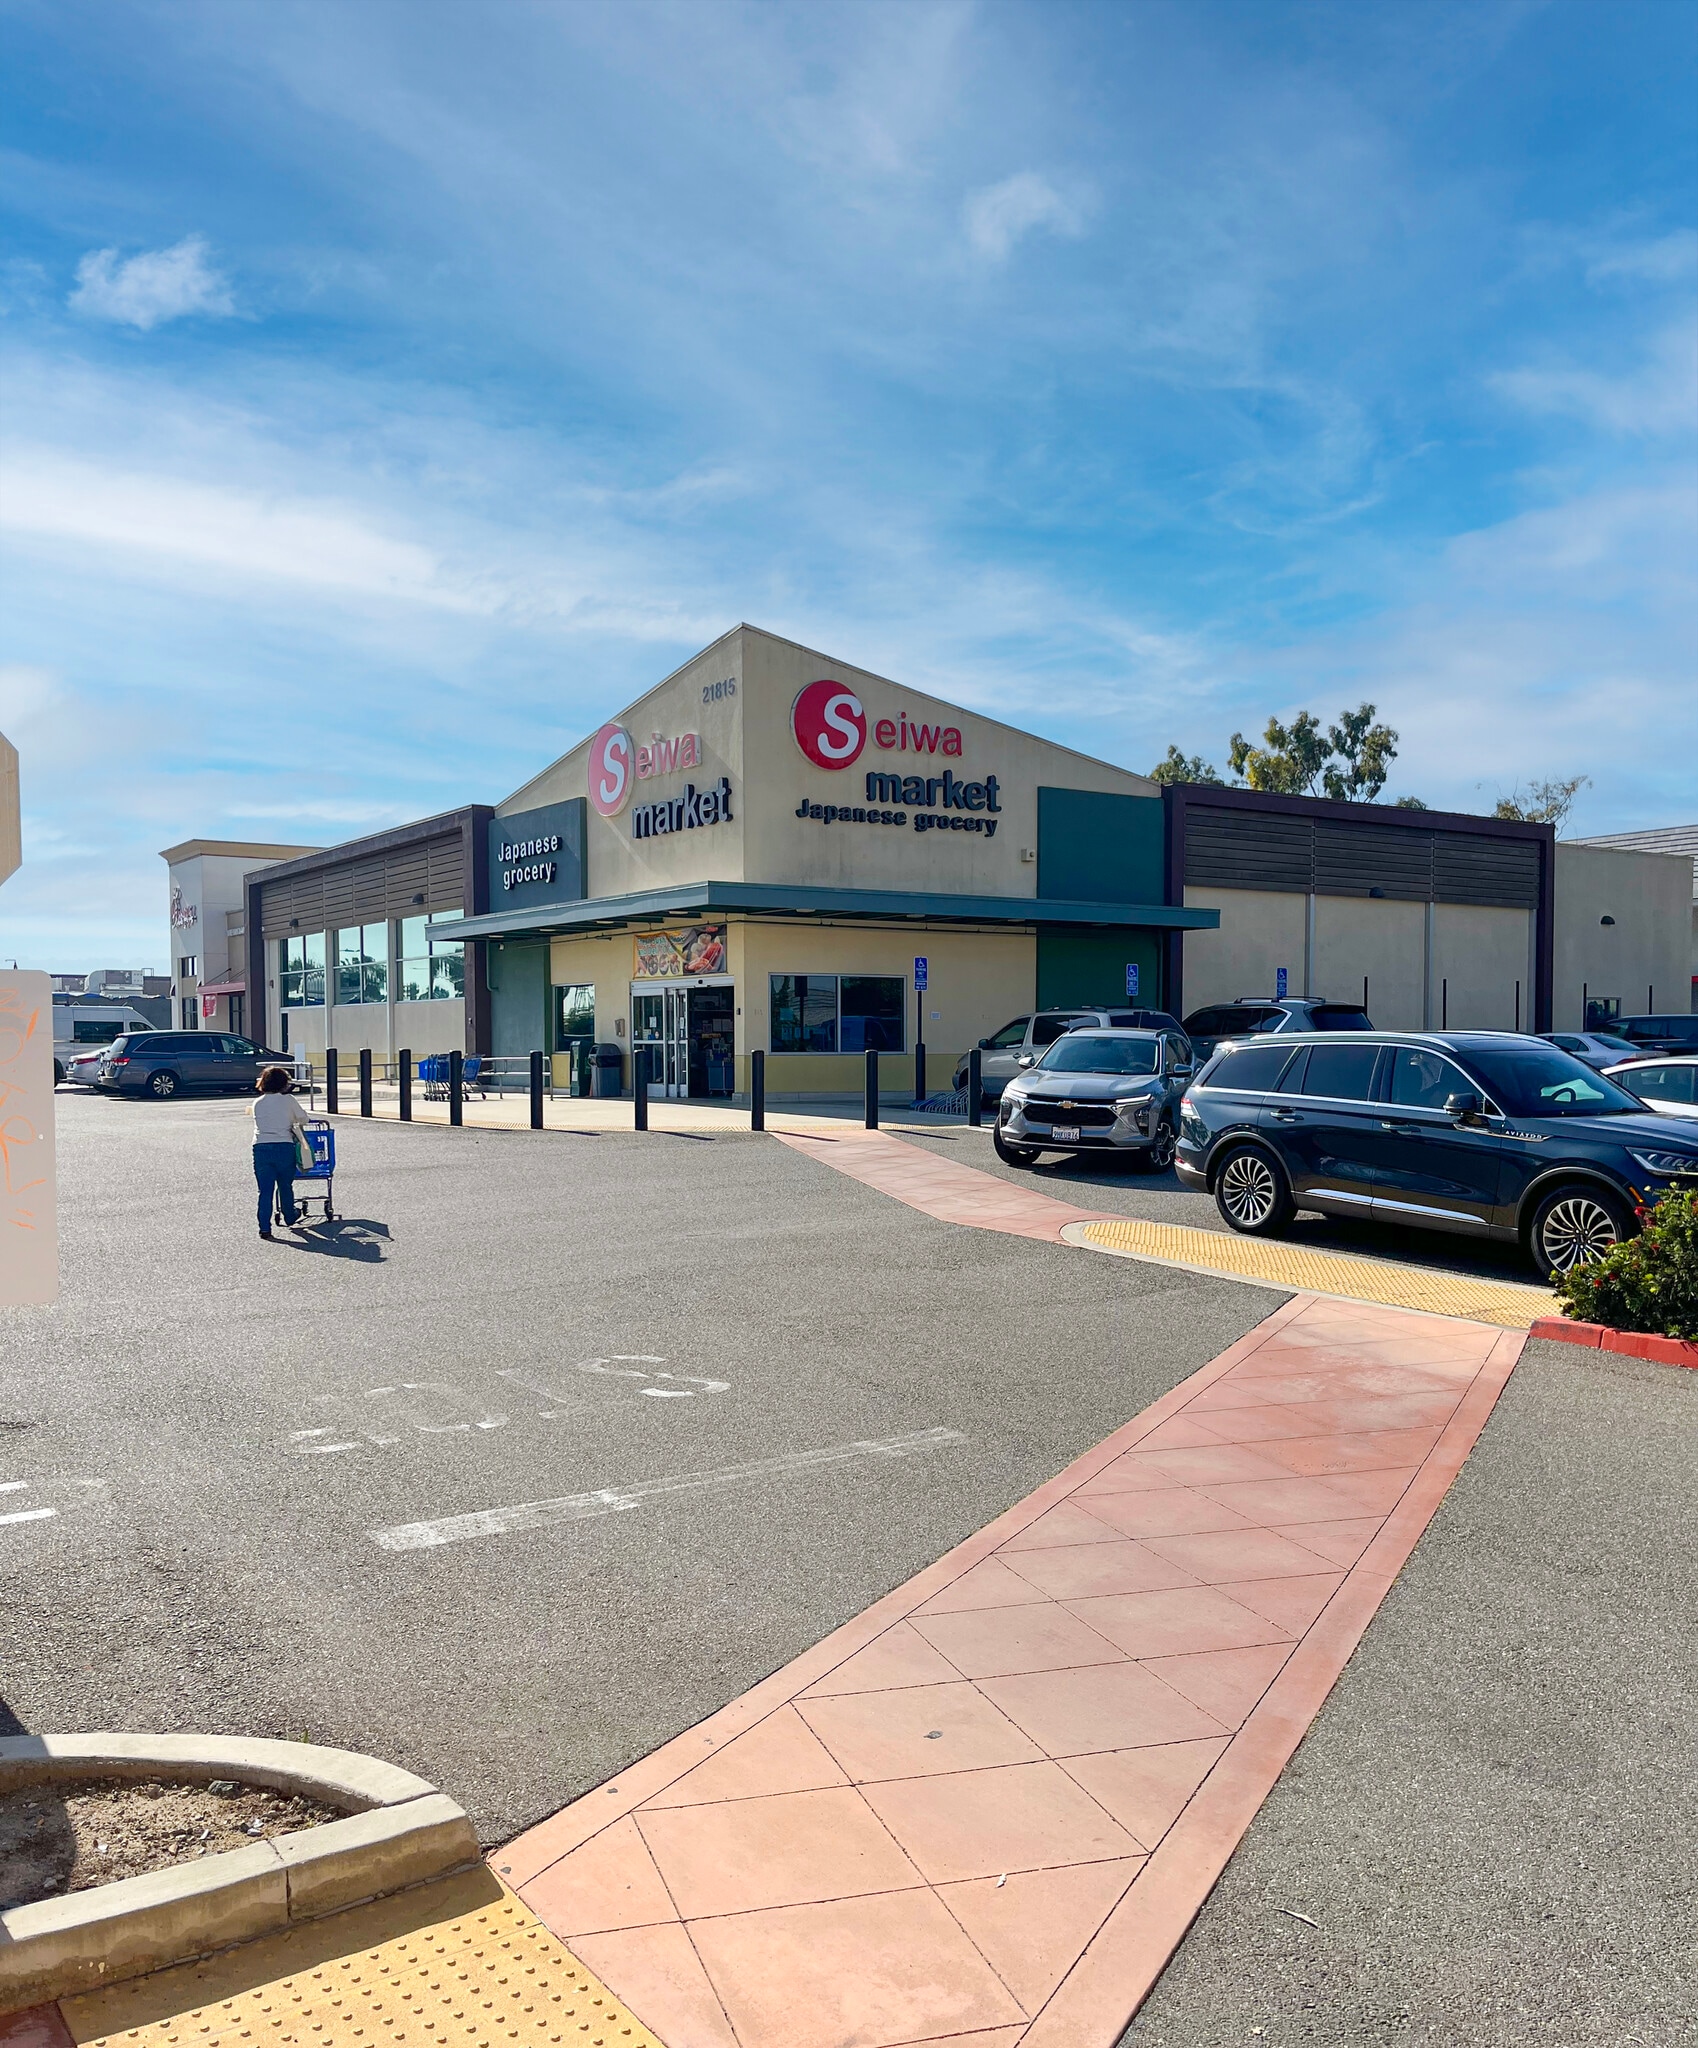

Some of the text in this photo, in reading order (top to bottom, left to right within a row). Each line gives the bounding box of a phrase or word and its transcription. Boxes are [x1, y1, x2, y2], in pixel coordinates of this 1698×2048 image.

[703, 677, 736, 704] 21815
[818, 693, 963, 759] Seiwa
[600, 732, 702, 803] Seiwa
[632, 777, 733, 838] market
[866, 769, 1001, 812] market
[796, 798, 998, 837] Japanese grocery
[498, 835, 560, 864] Japanese
[503, 862, 553, 890] grocery
[1505, 1130, 1542, 1139] AVIATOR
